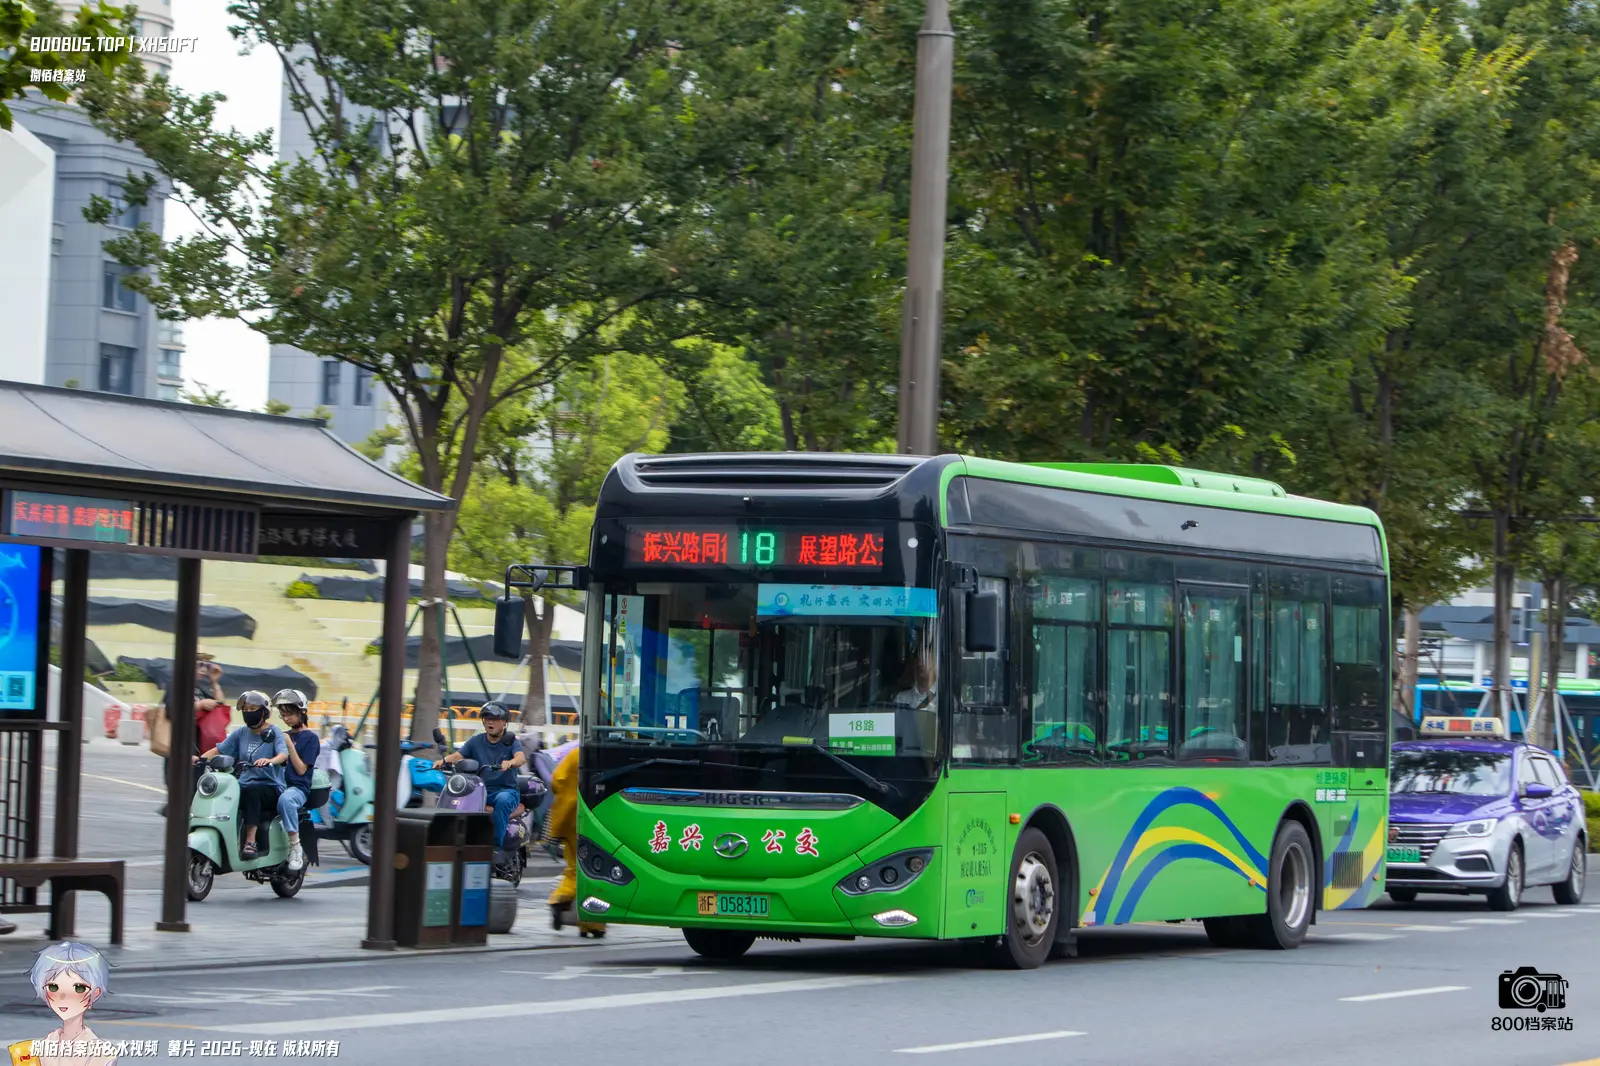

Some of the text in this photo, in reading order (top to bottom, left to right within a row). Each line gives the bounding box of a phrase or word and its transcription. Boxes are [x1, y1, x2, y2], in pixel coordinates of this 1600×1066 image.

[741, 532, 775, 565] 18
[848, 719, 875, 732] 18路
[705, 792, 764, 806] HIGER
[1315, 788, 1347, 802] 新能源
[649, 820, 820, 857] 嘉兴 公交
[720, 896, 768, 914] 05831D
